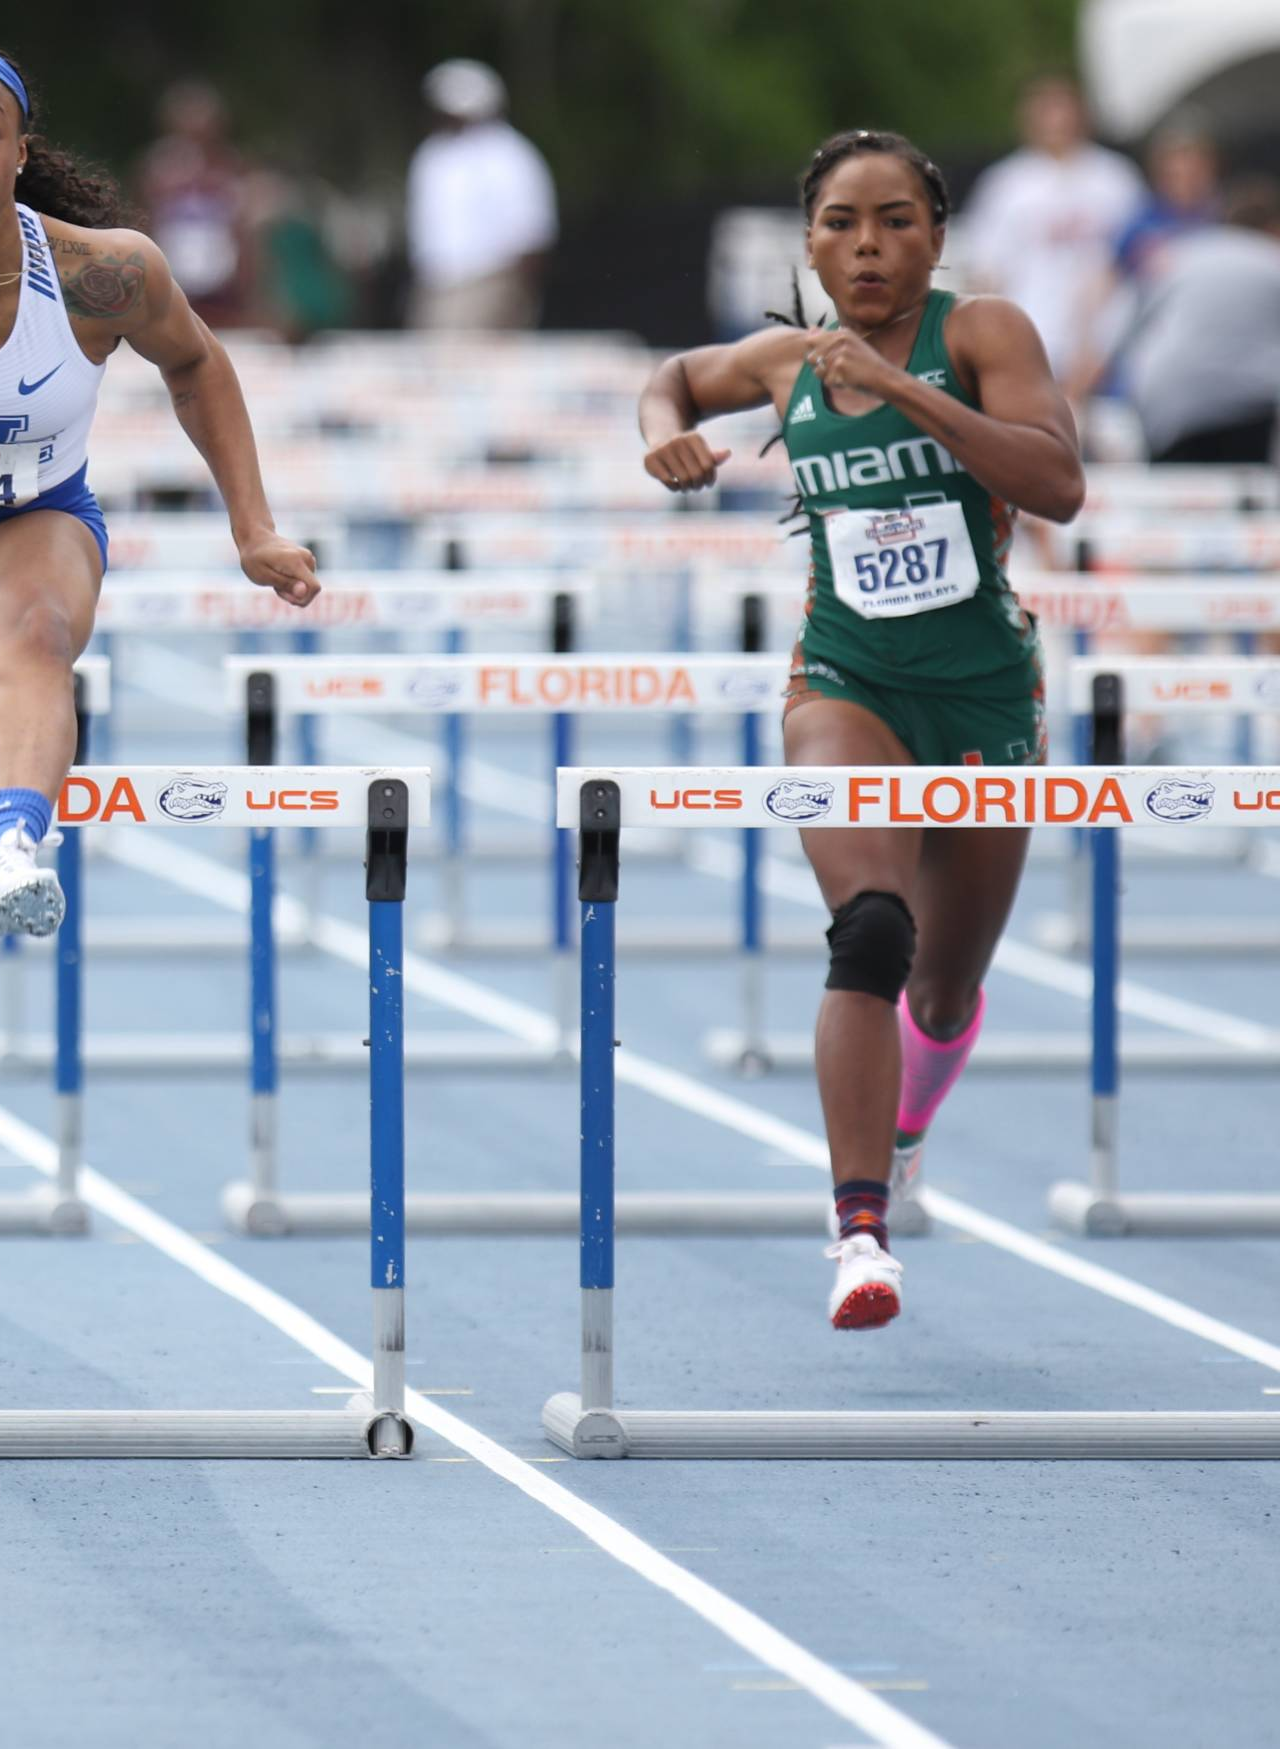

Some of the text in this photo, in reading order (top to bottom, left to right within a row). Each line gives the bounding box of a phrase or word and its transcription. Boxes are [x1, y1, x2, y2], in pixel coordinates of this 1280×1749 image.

[854, 537, 949, 594] 5287
[863, 583, 959, 609] FLORIDA RELAYS
[476, 665, 696, 705] FLORIDA
[245, 789, 340, 810] UCS
[650, 775, 1280, 824] UCS FLORIDA UC
